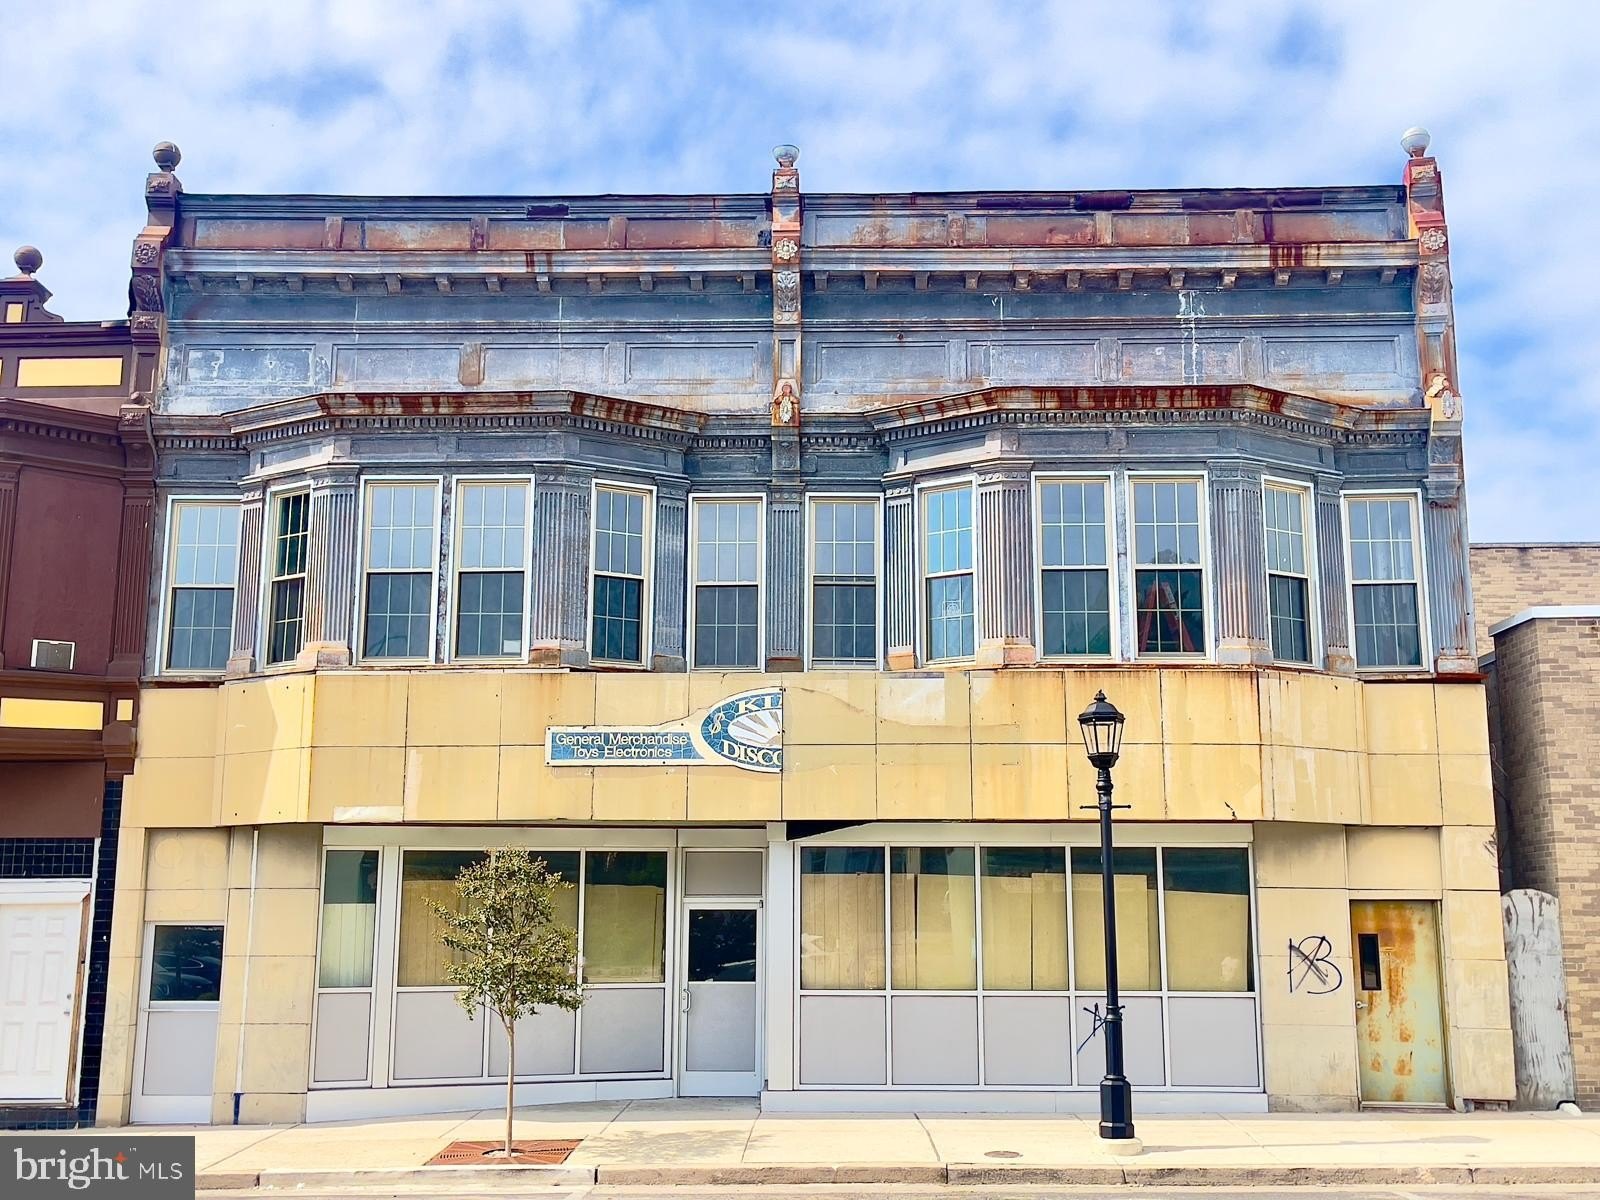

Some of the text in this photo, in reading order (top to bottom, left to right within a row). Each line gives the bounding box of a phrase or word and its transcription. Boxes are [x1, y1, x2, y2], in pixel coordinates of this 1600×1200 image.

[736, 695, 782, 713] KI
[556, 733, 688, 745] General Merchandise
[572, 746, 673, 760] Toys Electronics
